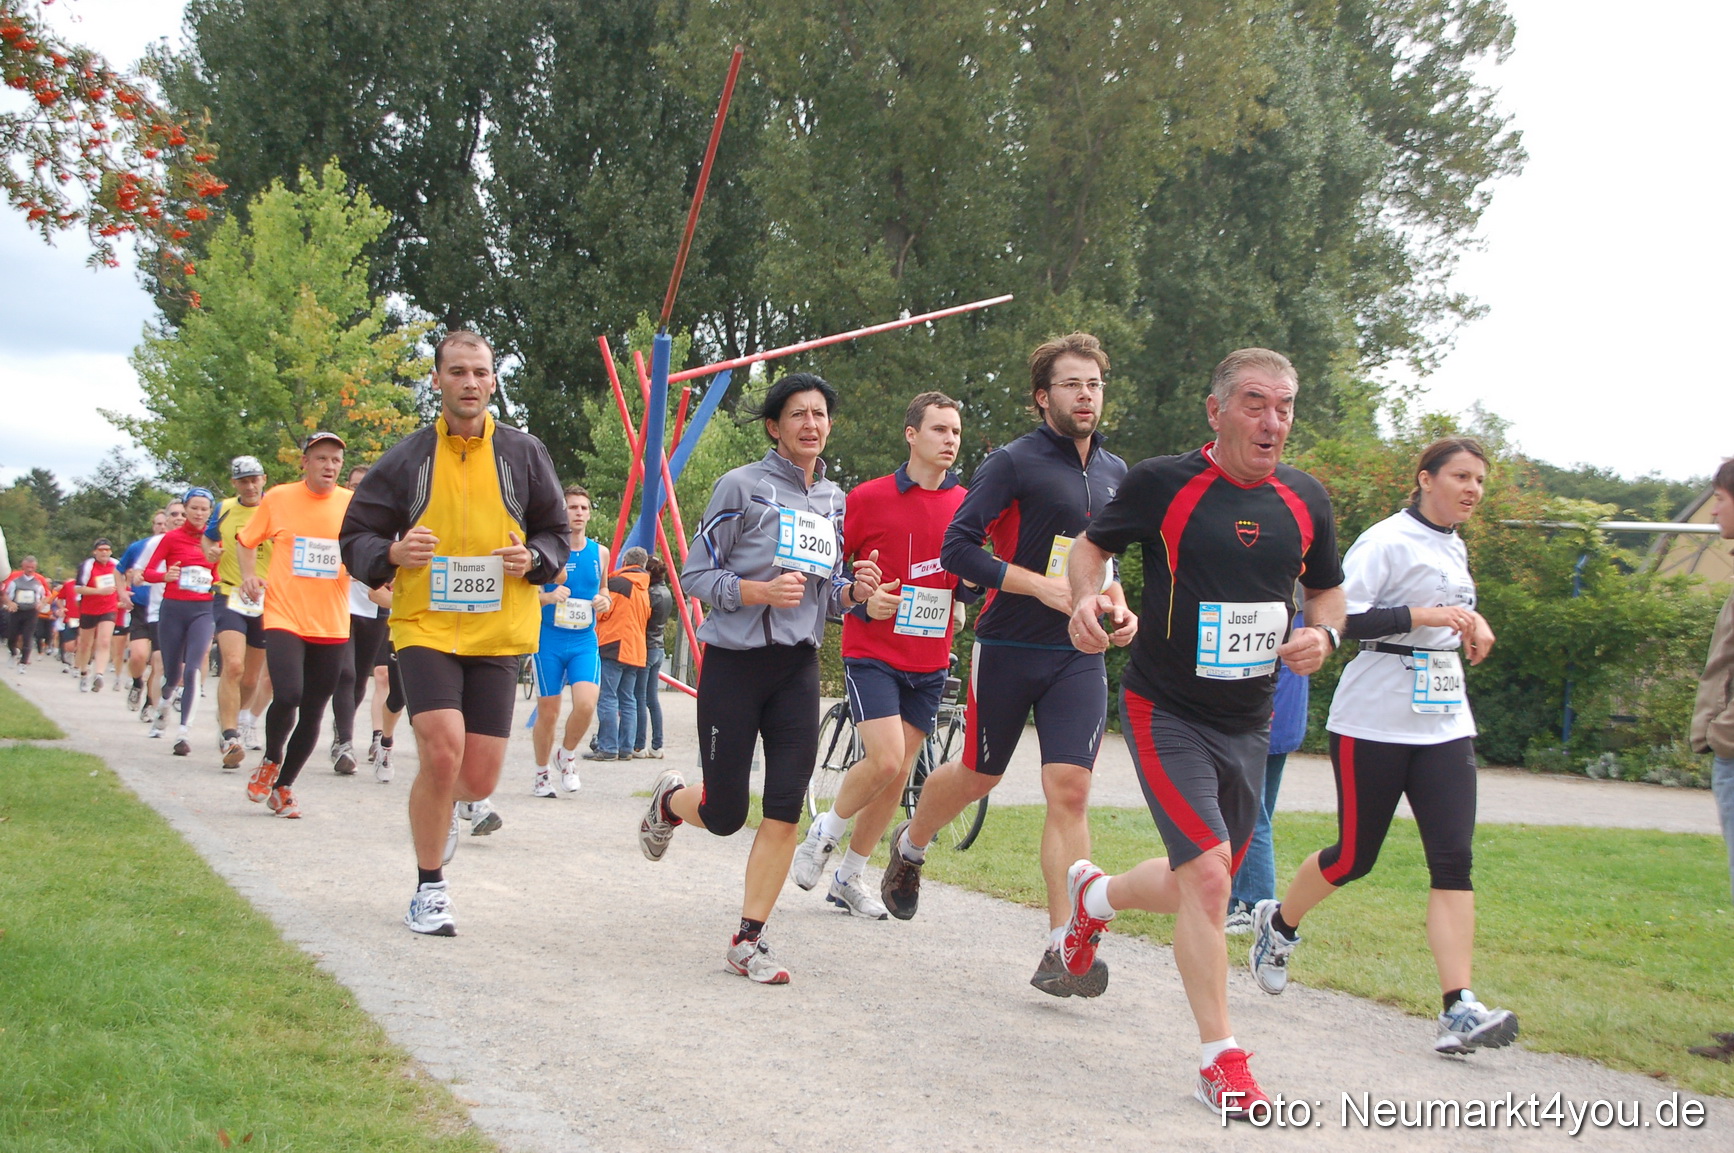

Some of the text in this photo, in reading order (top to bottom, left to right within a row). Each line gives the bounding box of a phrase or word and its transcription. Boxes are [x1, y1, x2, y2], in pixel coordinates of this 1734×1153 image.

[799, 516, 816, 529] Irmi
[785, 529, 789, 538] C
[799, 534, 831, 556] 3200
[308, 552, 337, 565] 3186
[453, 561, 486, 572] Thomas
[436, 576, 441, 585] C
[453, 577, 496, 593] 2882
[917, 591, 939, 605] Philipp
[569, 610, 587, 621] 358
[914, 605, 946, 621] 2007
[1228, 610, 1258, 625] Josef
[1206, 631, 1213, 642] C
[1228, 631, 1277, 653] 2176
[1433, 675, 1460, 692] 3204
